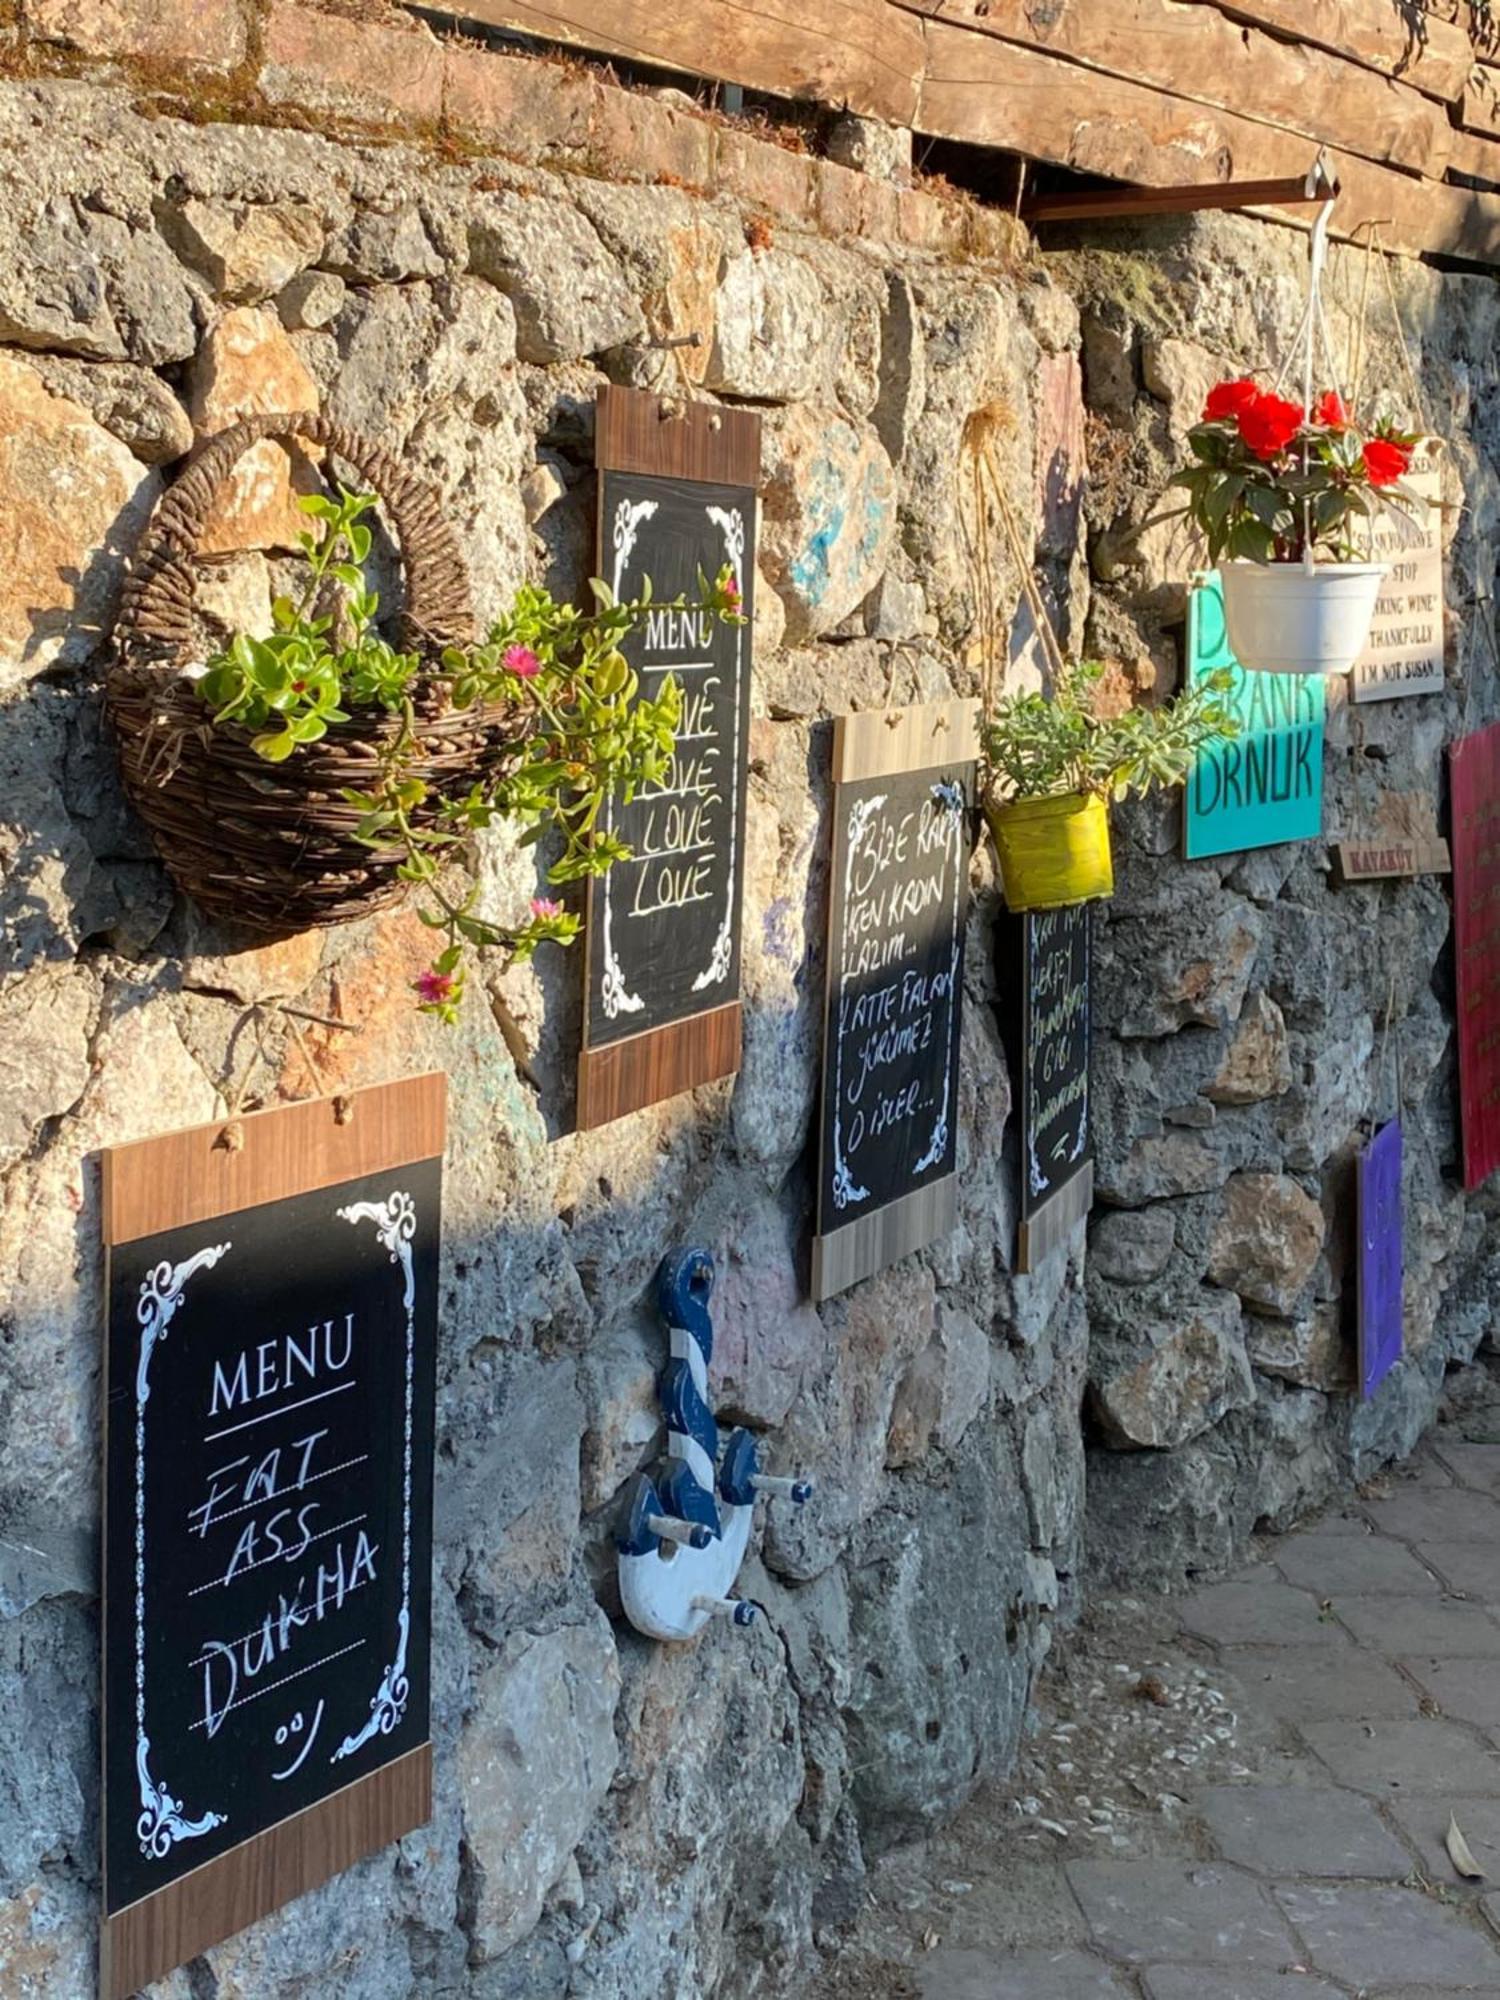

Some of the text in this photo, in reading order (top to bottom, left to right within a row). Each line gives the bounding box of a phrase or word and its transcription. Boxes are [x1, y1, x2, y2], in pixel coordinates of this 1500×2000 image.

[1392, 562, 1418, 582] STOP
[644, 607, 713, 650] MENU
[1369, 624, 1433, 648] THANKFULLY
[1373, 596, 1404, 616] NKING
[1382, 661, 1401, 682] NOT
[672, 677, 721, 741] OVE
[1195, 728, 1312, 817] DRNUK
[643, 794, 722, 854] LOVE
[634, 854, 716, 915] LOVE
[207, 1313, 355, 1417] MENU
[187, 1428, 329, 1539] FAT
[224, 1502, 321, 1587] ASS
